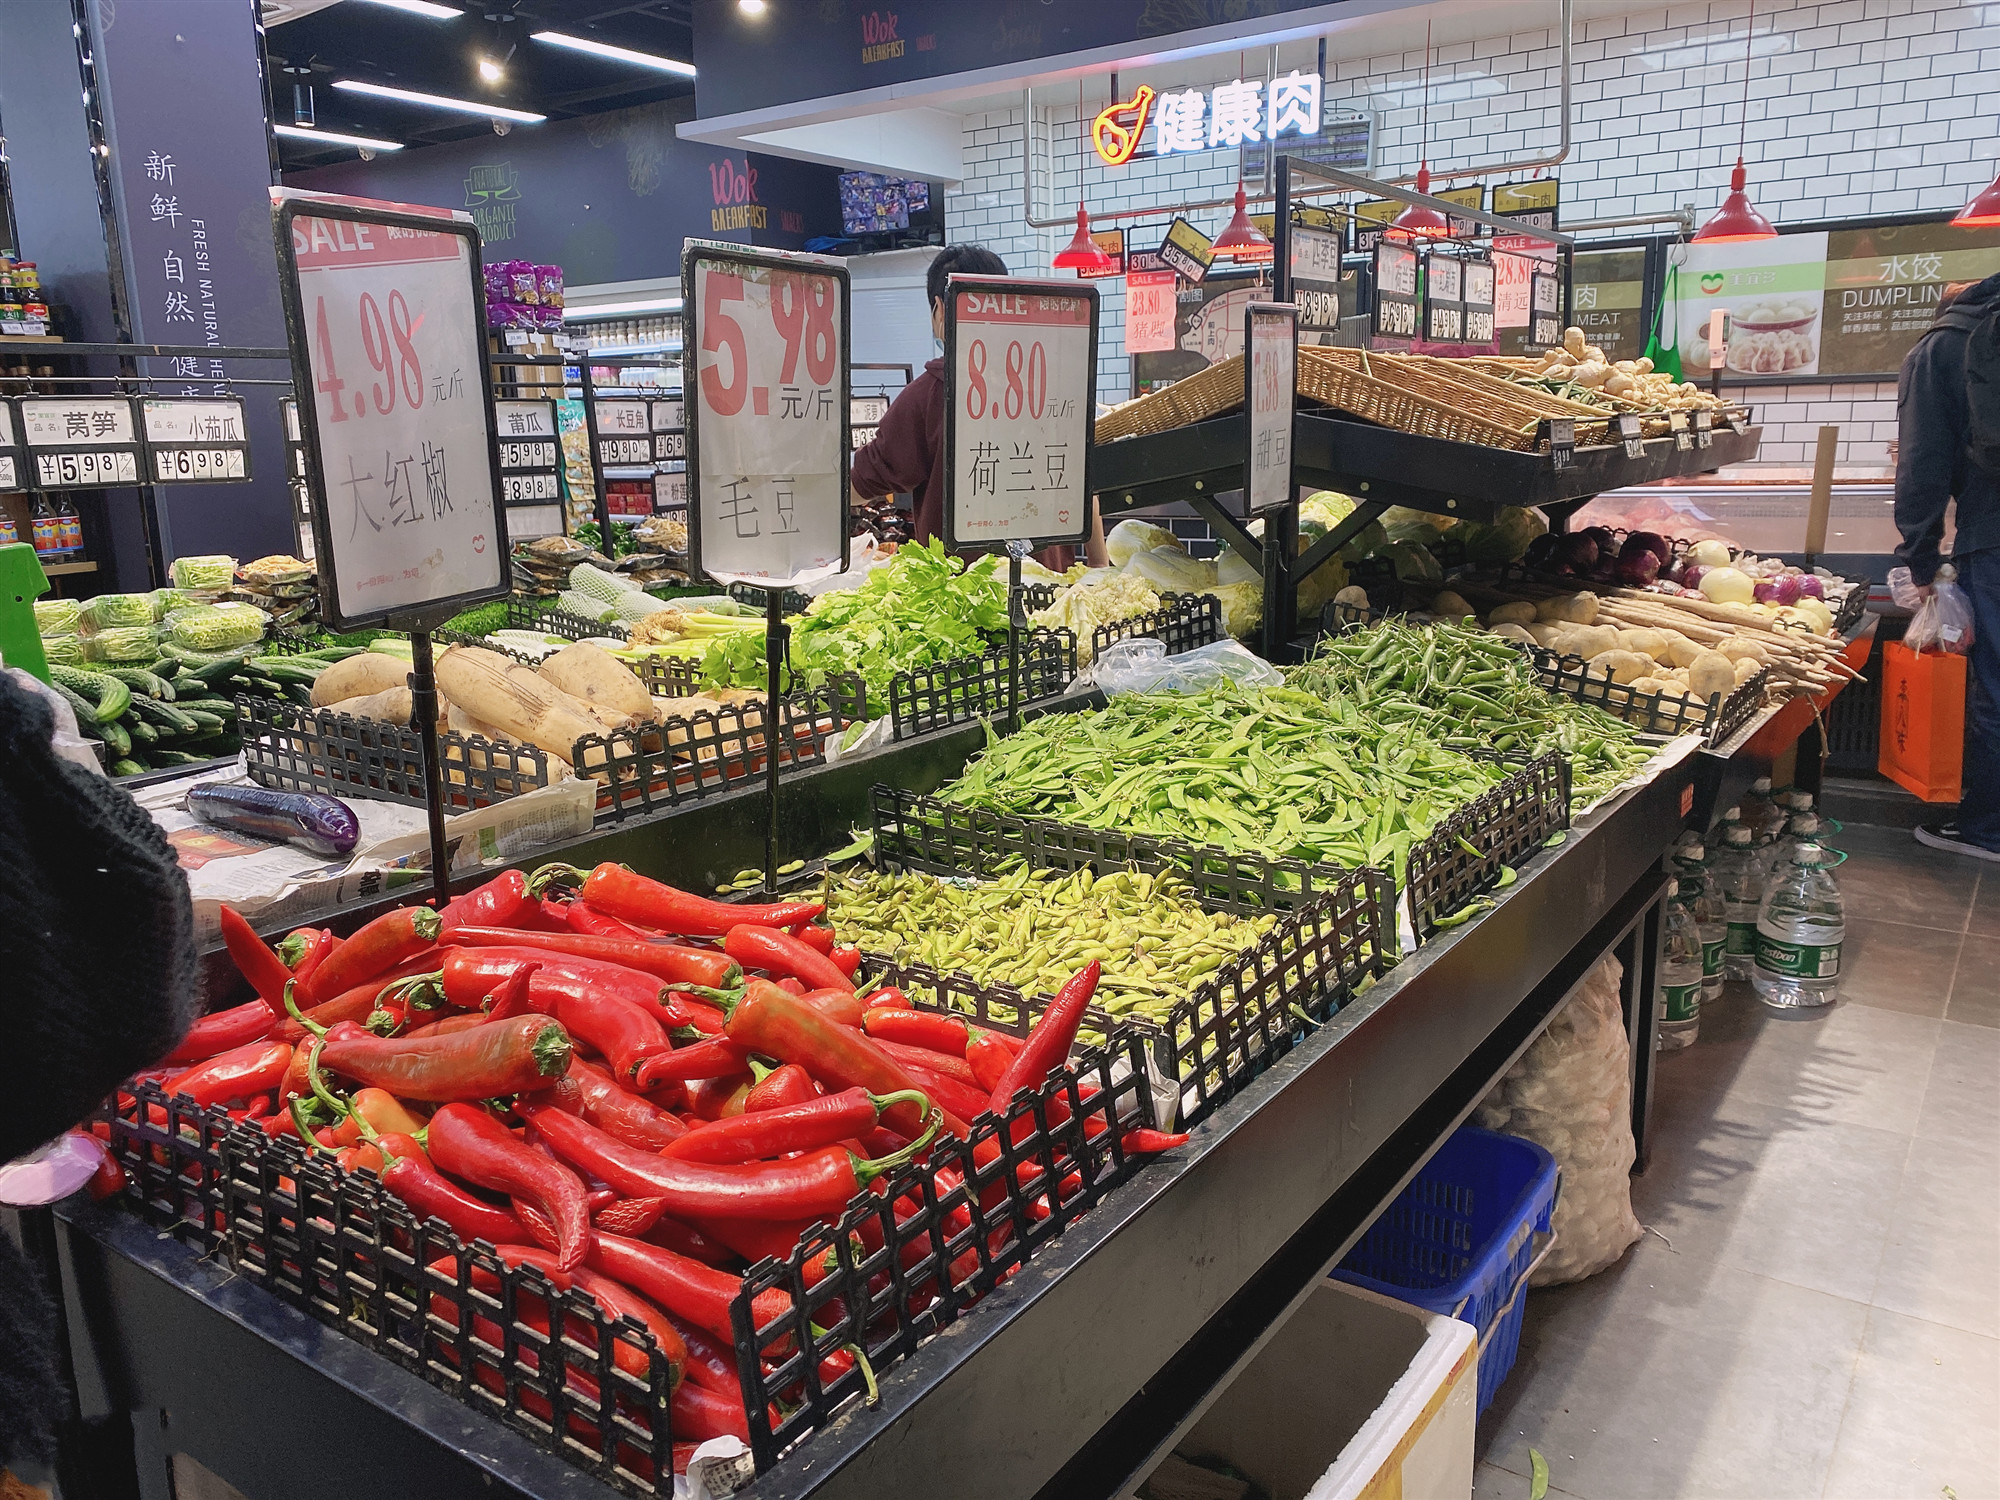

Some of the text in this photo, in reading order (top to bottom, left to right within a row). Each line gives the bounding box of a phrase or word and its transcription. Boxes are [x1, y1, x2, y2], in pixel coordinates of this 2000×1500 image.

[861, 11, 898, 44] Wok
[863, 40, 905, 64] BREAKFAST
[1154, 70, 1322, 154] 健康肉
[143, 149, 184, 228] 新鲜
[709, 159, 759, 205] Wok
[293, 217, 376, 255] SALE
[711, 205, 768, 232] BREAKFAST
[191, 219, 210, 272] FRESH
[1499, 238, 1525, 249] SALE
[1131, 275, 1153, 285] SALE
[1878, 253, 1943, 284] 水饺
[163, 250, 195, 323] 自然
[967, 292, 1028, 315] SALE
[1132, 290, 1161, 316] 23.80
[1498, 292, 1528, 312] 清远
[1574, 284, 1598, 310] 肉
[199, 279, 220, 348] NATURAL
[1576, 312, 1622, 327] MEAT
[316, 289, 424, 423] 4.98
[701, 269, 837, 416] 5.98
[781, 387, 834, 421] 元/斤
[966, 339, 1076, 420] 8.80 元/斤
[62, 410, 118, 439] 莴笋
[189, 415, 238, 442] 小茄瓜
[616, 409, 645, 430] 长豆角
[1256, 428, 1287, 472] 甜豆
[968, 440, 1069, 497] 荷兰豆
[340, 440, 454, 544] 大红椒
[719, 476, 801, 539] 毛豆
